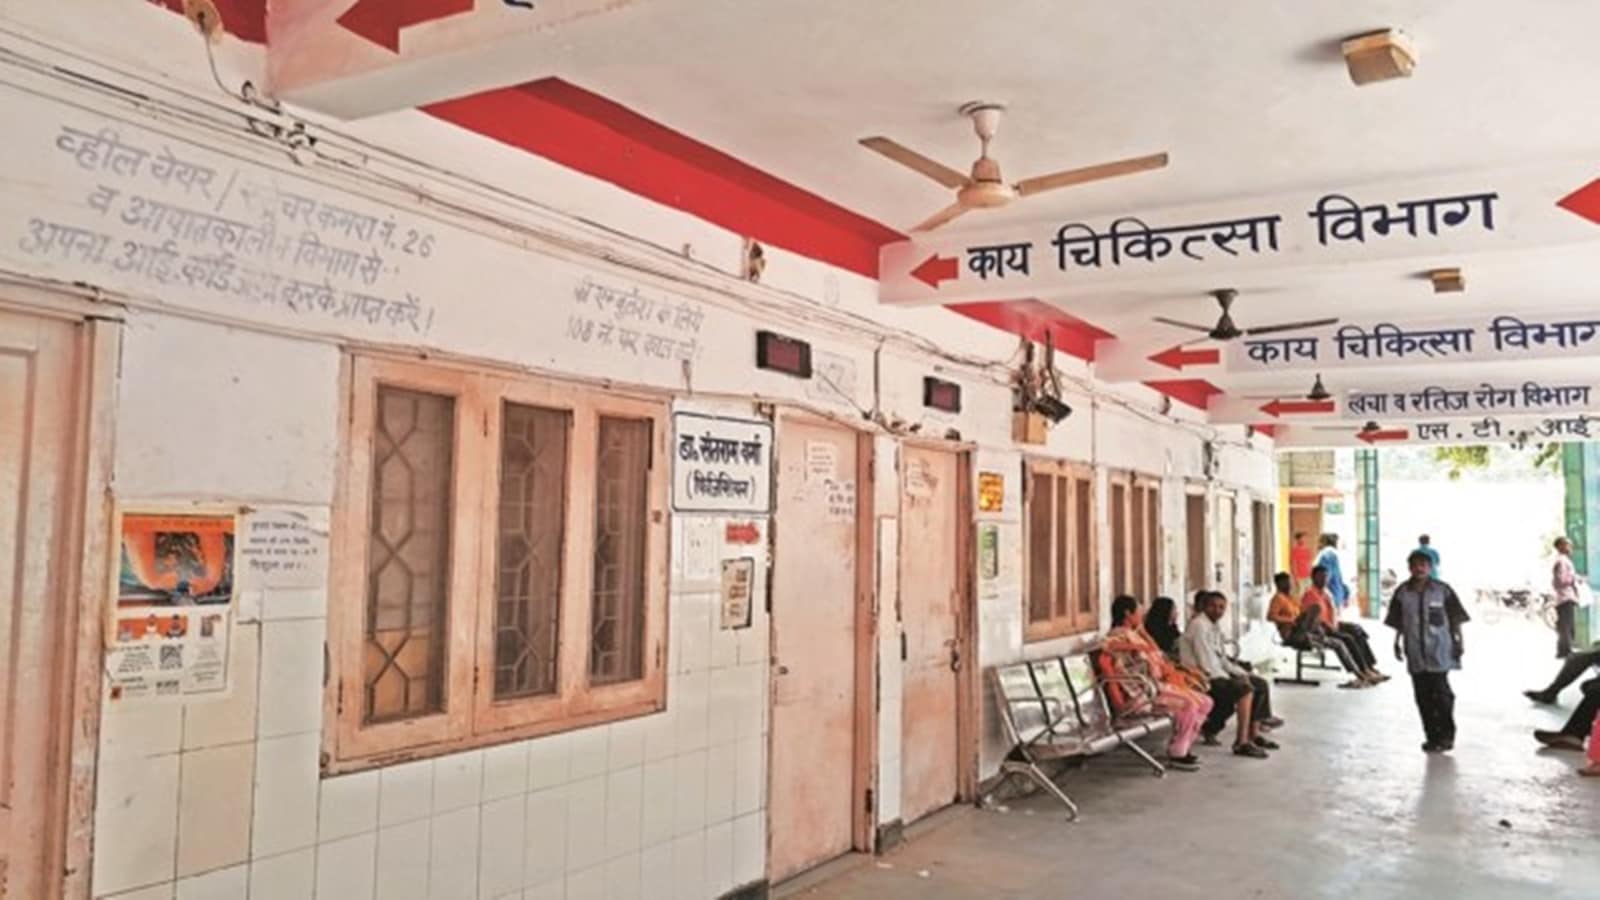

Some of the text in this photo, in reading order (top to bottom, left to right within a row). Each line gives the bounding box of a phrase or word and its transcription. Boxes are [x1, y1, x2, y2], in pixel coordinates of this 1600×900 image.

[56, 127, 151, 176] व्हील
[151, 145, 217, 199] चेयर
[318, 202, 380, 242] कमरा
[403, 228, 436, 259] 26
[87, 183, 121, 216] व
[19, 218, 113, 265] अपना
[965, 191, 1500, 281] काय चिकित्सा विभाग
[1243, 337, 1320, 365] काय
[1334, 322, 1476, 361] चिकित्सा
[1393, 393, 1406, 412] व
[1409, 386, 1470, 412] रतिज
[1473, 383, 1517, 409] रोग
[1521, 381, 1592, 408] विभाग
